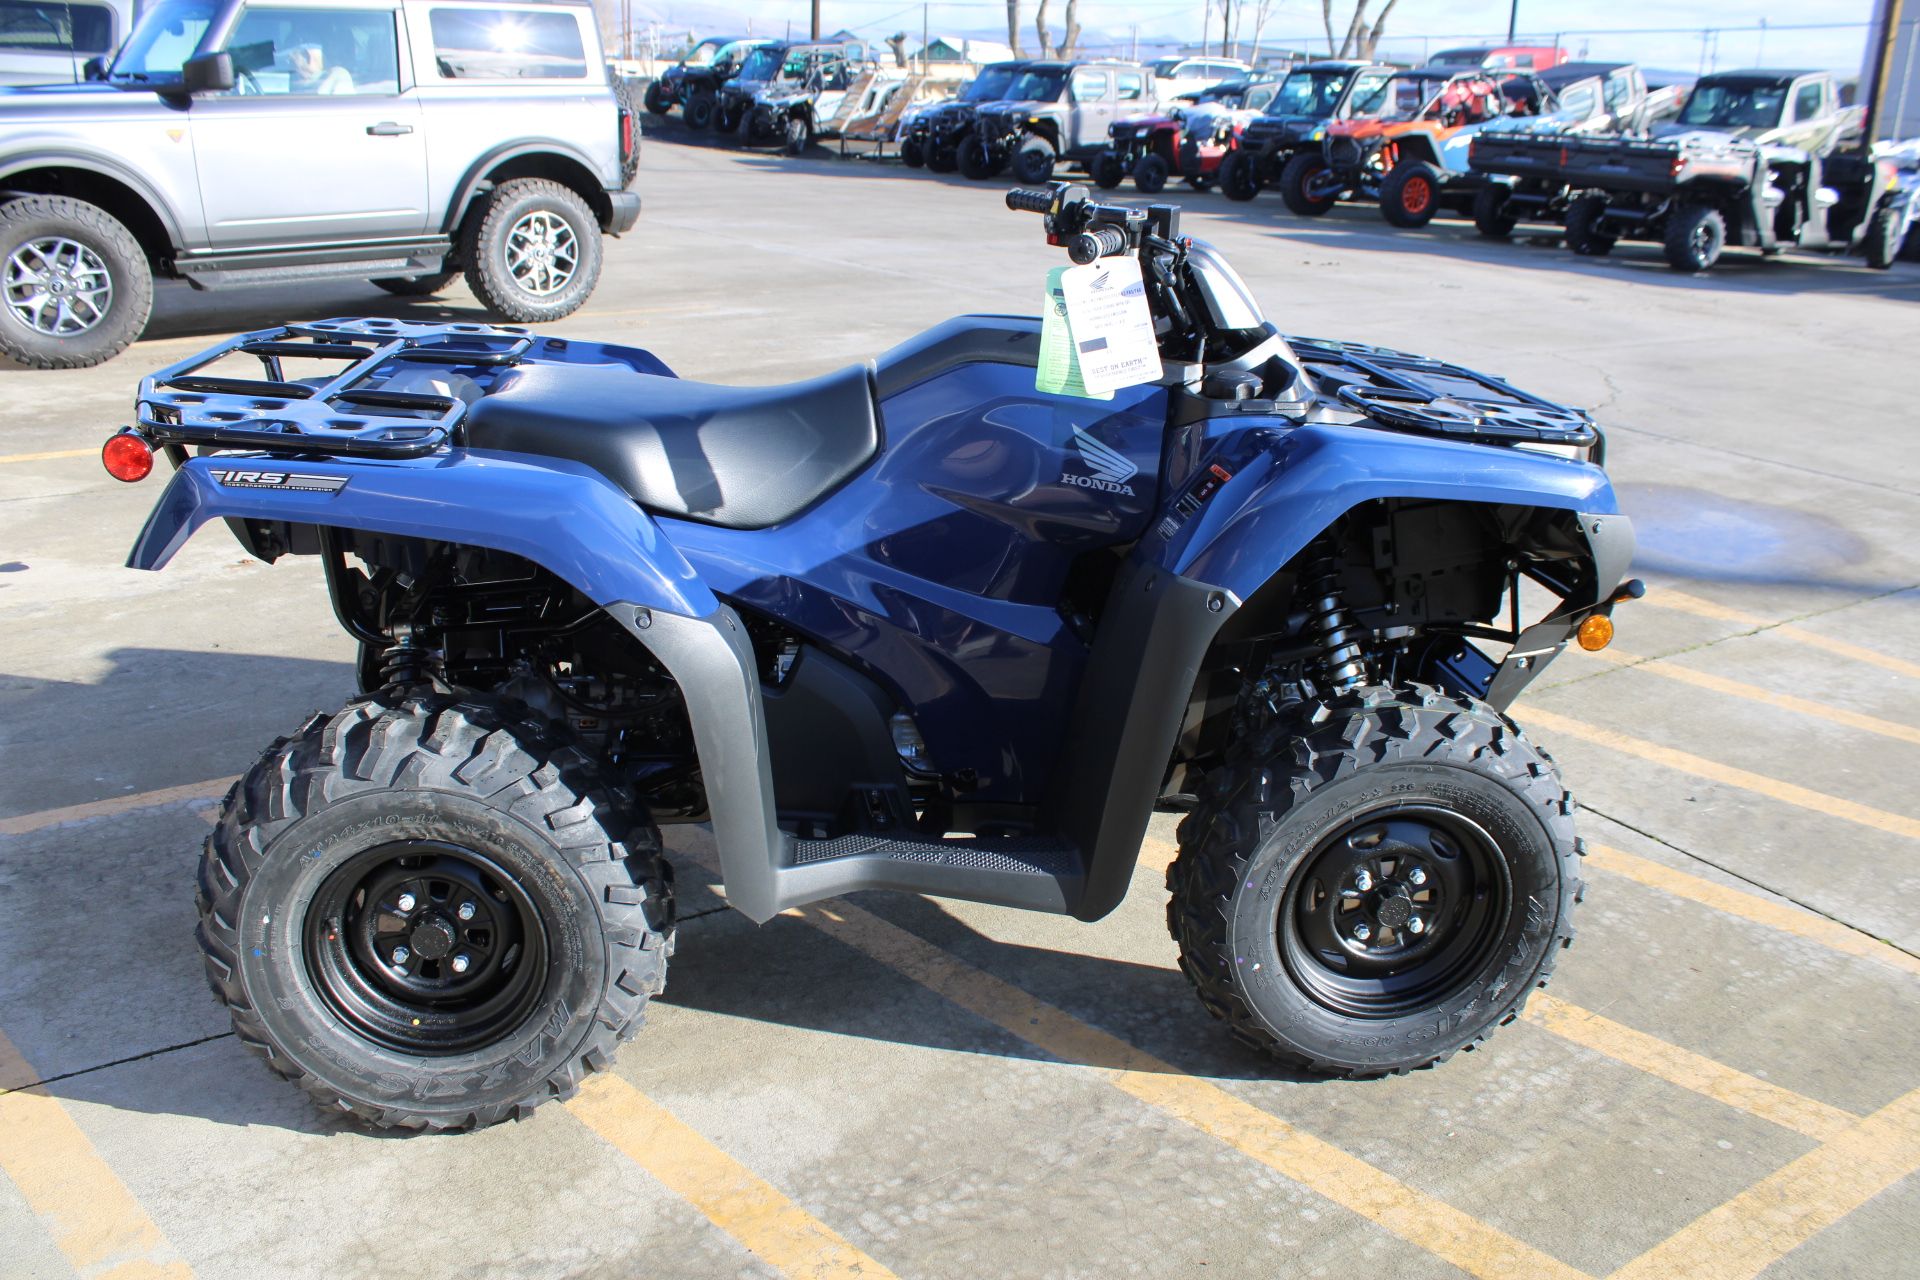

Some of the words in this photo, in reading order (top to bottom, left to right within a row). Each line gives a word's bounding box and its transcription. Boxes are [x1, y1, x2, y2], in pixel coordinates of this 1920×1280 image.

[1121, 358, 1143, 368] EARTH
[224, 471, 285, 484] IRS
[1060, 473, 1136, 497] HONDA
[1406, 894, 1545, 1044] MAXXIS
[376, 998, 571, 1098] MAXXIS
